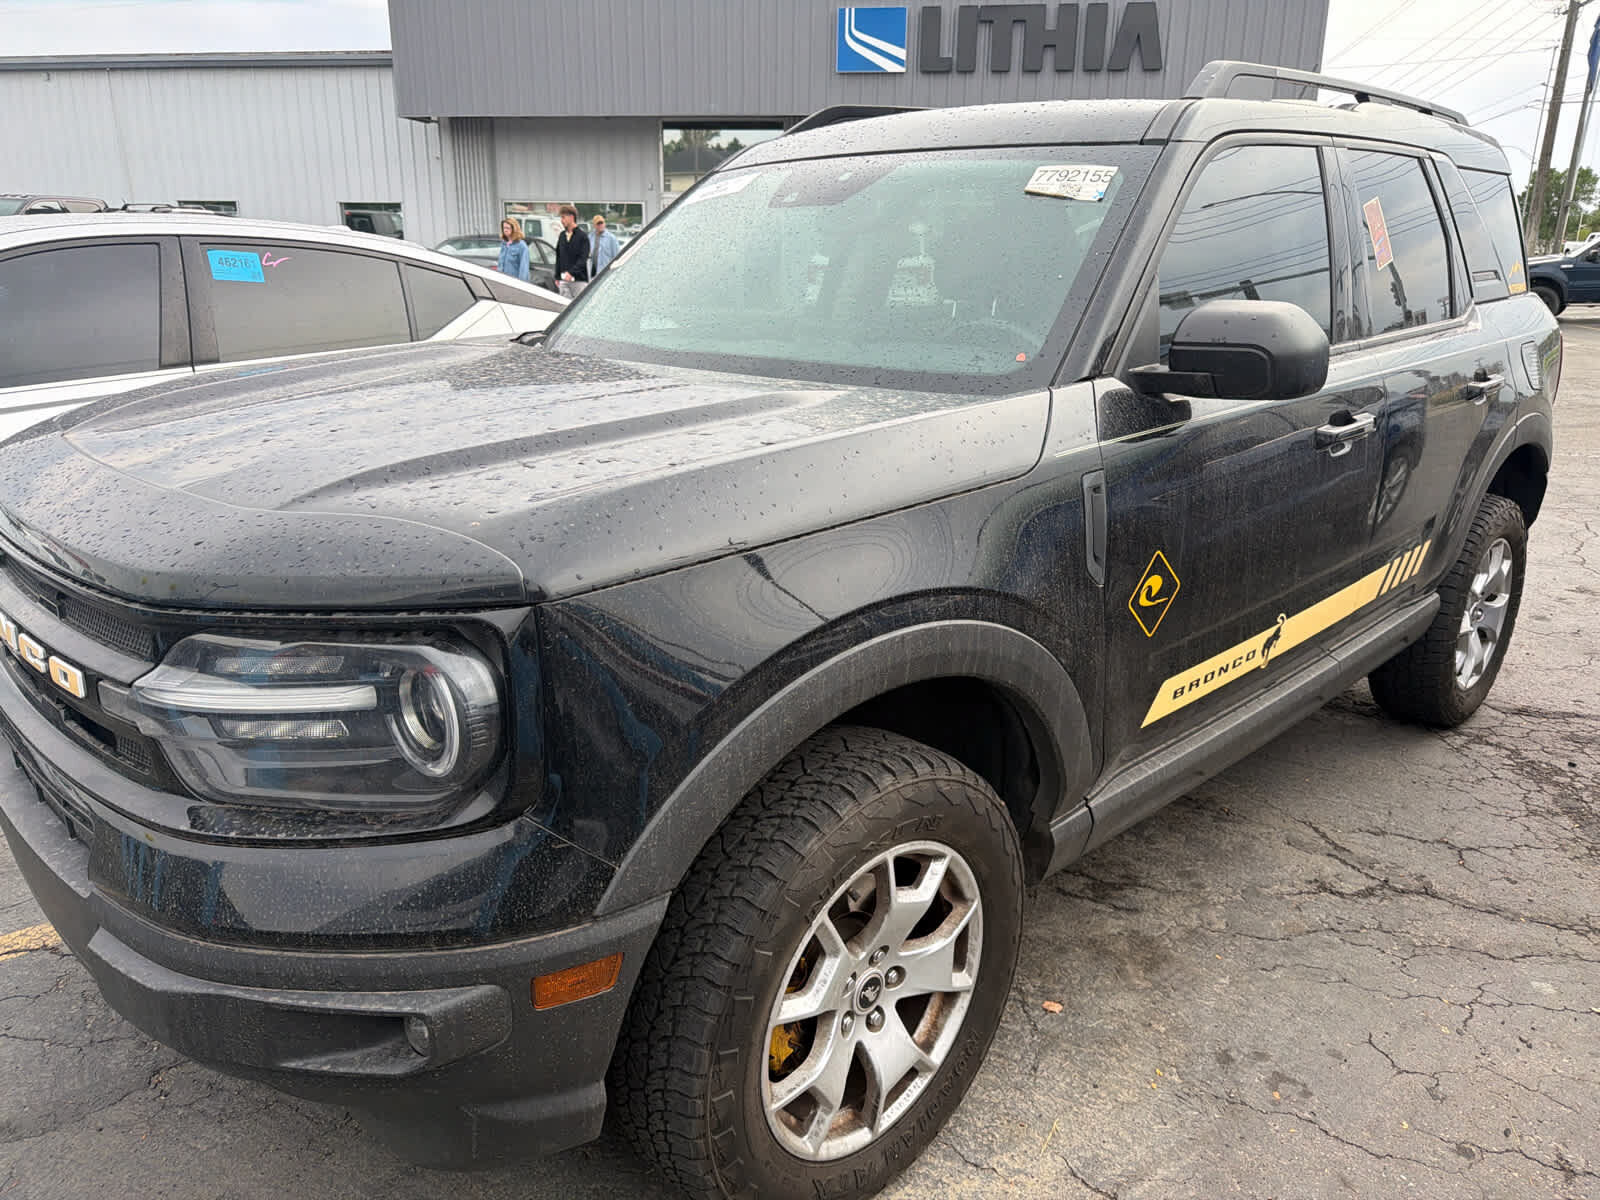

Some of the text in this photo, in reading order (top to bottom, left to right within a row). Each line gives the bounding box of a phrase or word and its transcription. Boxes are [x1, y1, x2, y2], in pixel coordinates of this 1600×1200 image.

[920, 2, 1162, 73] LITHIA
[1035, 169, 1114, 184] 7792155
[1172, 648, 1257, 700] BRONCO
